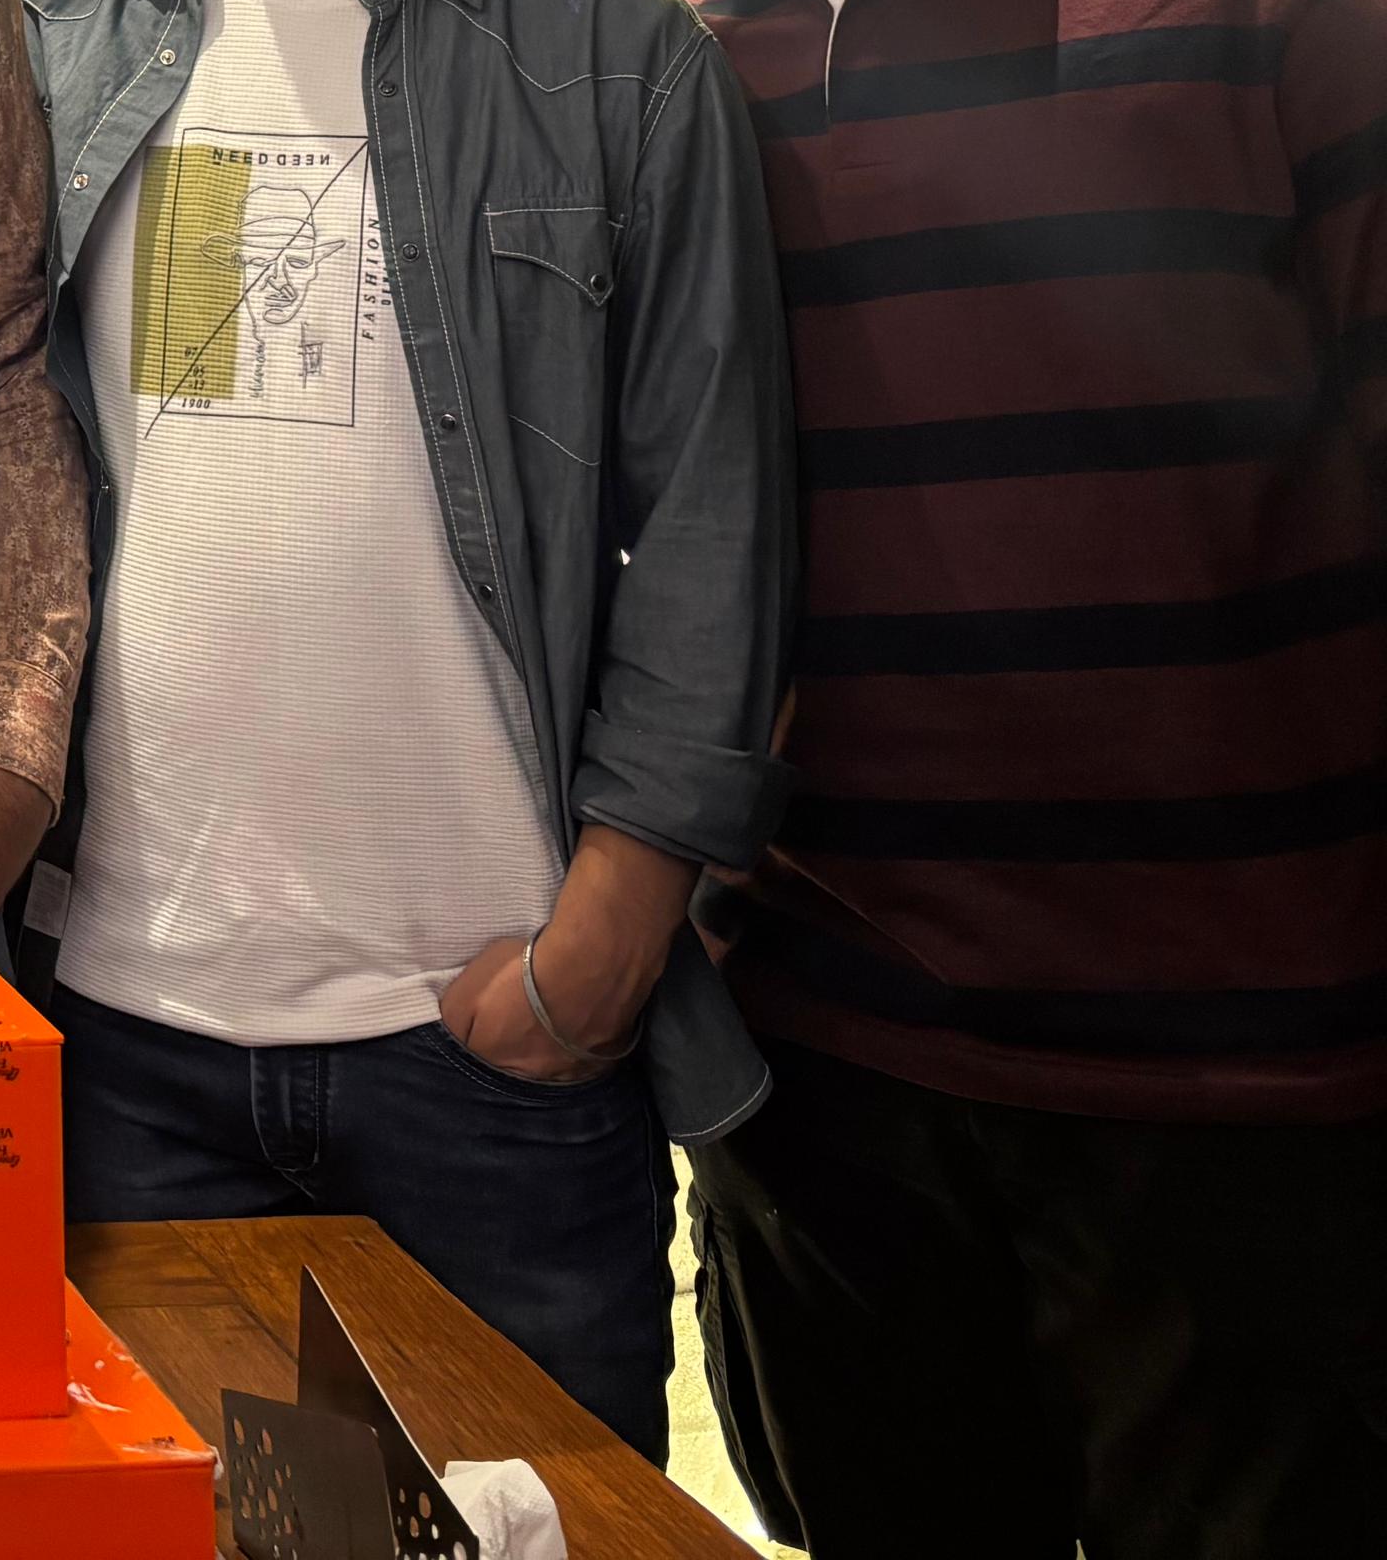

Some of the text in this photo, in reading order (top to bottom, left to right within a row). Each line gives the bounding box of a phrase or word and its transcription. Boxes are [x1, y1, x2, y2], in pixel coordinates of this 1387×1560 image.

[212, 147, 268, 166] NEED
[361, 218, 380, 341] FASHION
[181, 397, 212, 409] 1900
